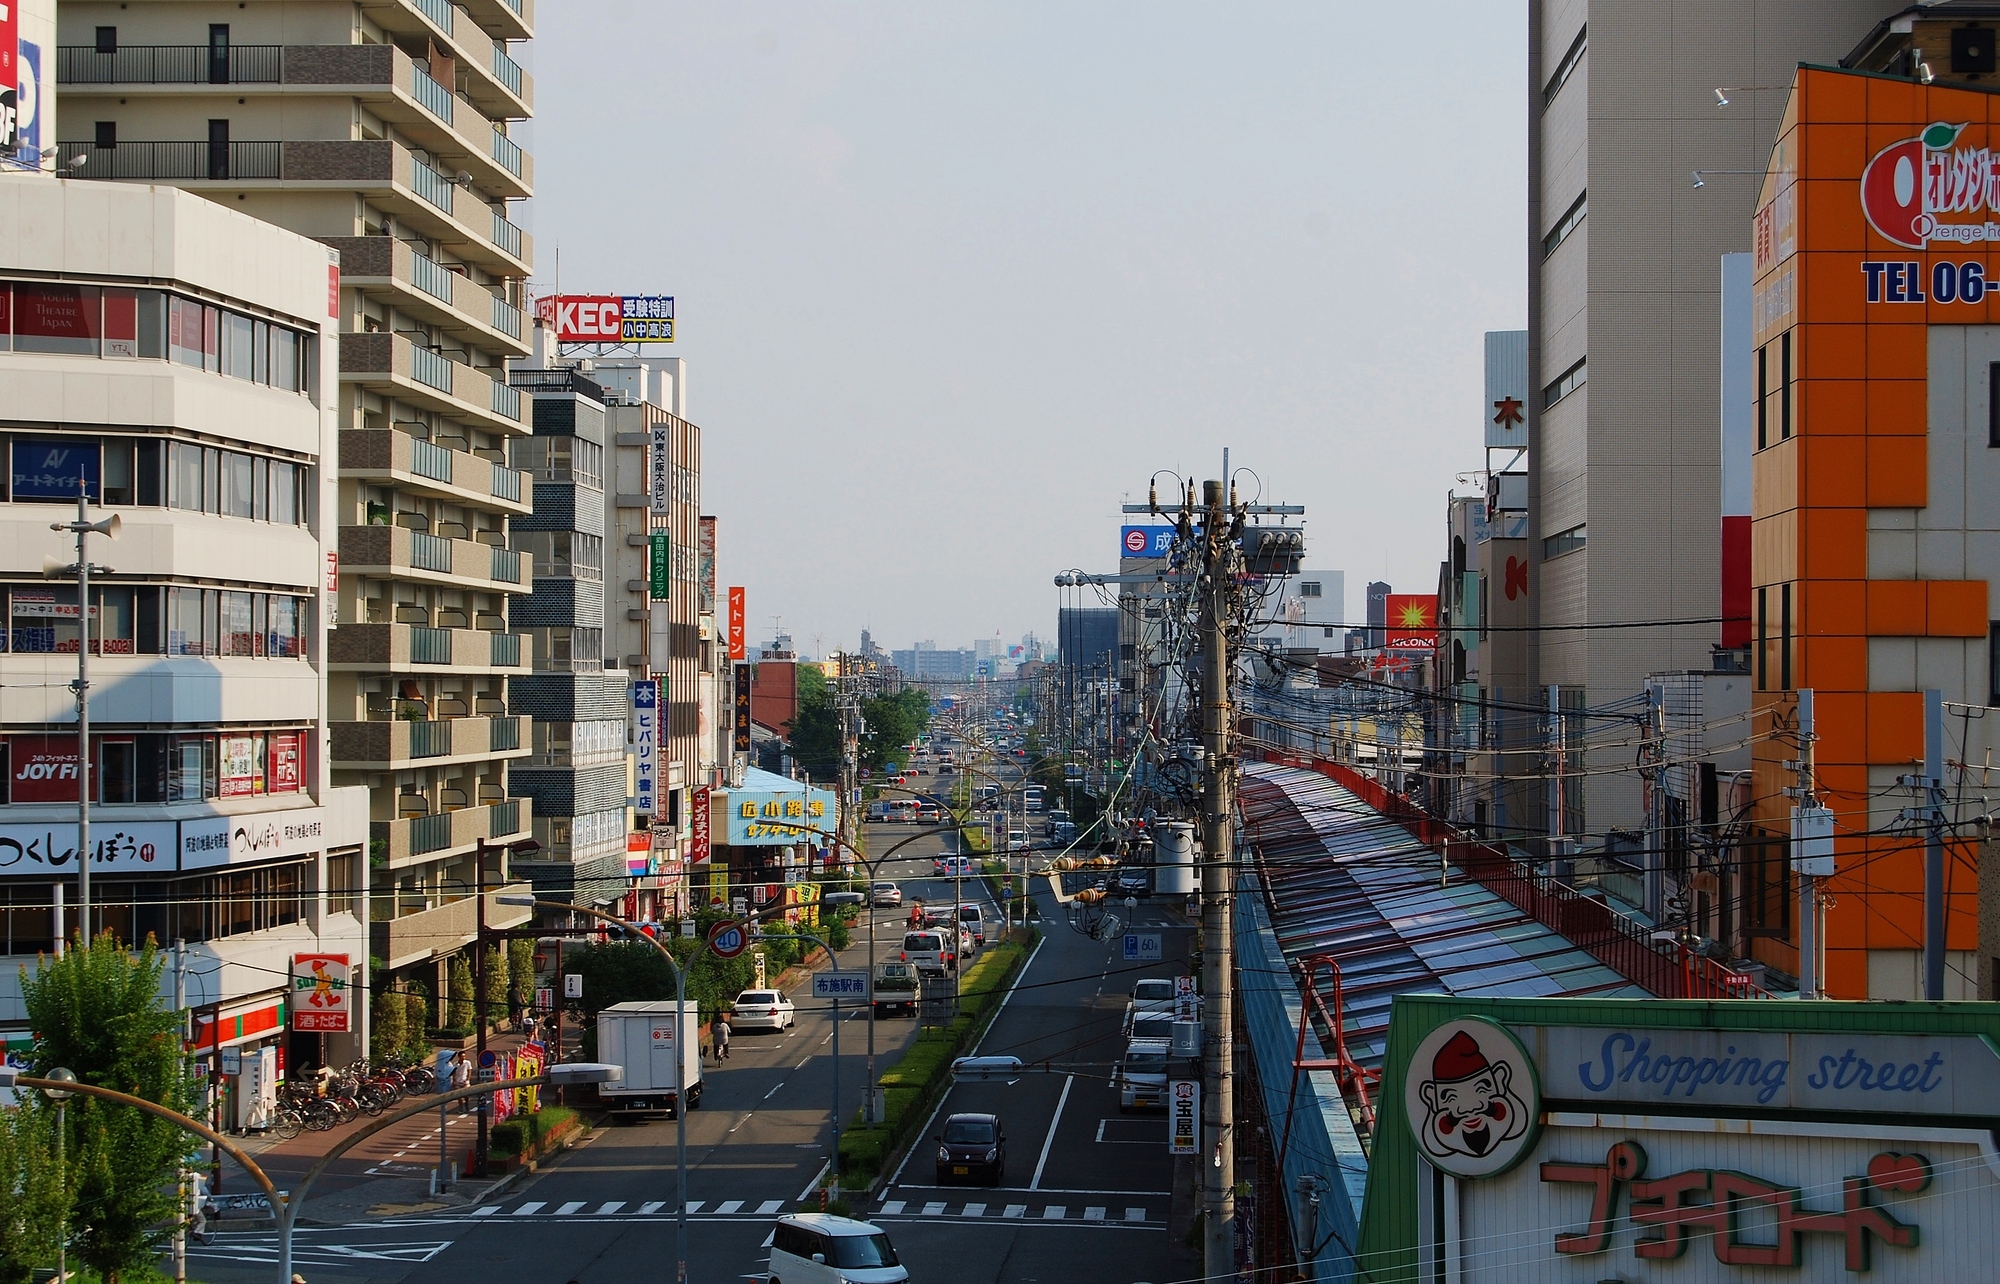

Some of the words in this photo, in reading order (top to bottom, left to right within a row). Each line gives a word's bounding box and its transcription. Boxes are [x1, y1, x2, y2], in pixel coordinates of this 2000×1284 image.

[1862, 262, 1925, 303] TEL
[1932, 261, 2000, 304] 06-
[557, 303, 620, 335] KEC
[623, 299, 673, 318] 受験特訓
[111, 343, 129, 353] YTJ
[13, 474, 97, 488] アートネイチー
[654, 536, 665, 599] 森田内科クリニック
[730, 592, 743, 654] イトマン
[636, 685, 654, 704] 本
[16, 763, 60, 780] JOY
[638, 713, 652, 809] ヒバリヤ書店
[694, 803, 708, 857] メガネスーパー
[716, 932, 740, 947] 40
[816, 978, 864, 993] 布施駅南
[300, 1014, 345, 1028] 酒・たばこ
[1579, 1031, 1790, 1105] Shopping
[1176, 1099, 1193, 1136] 宝屋
